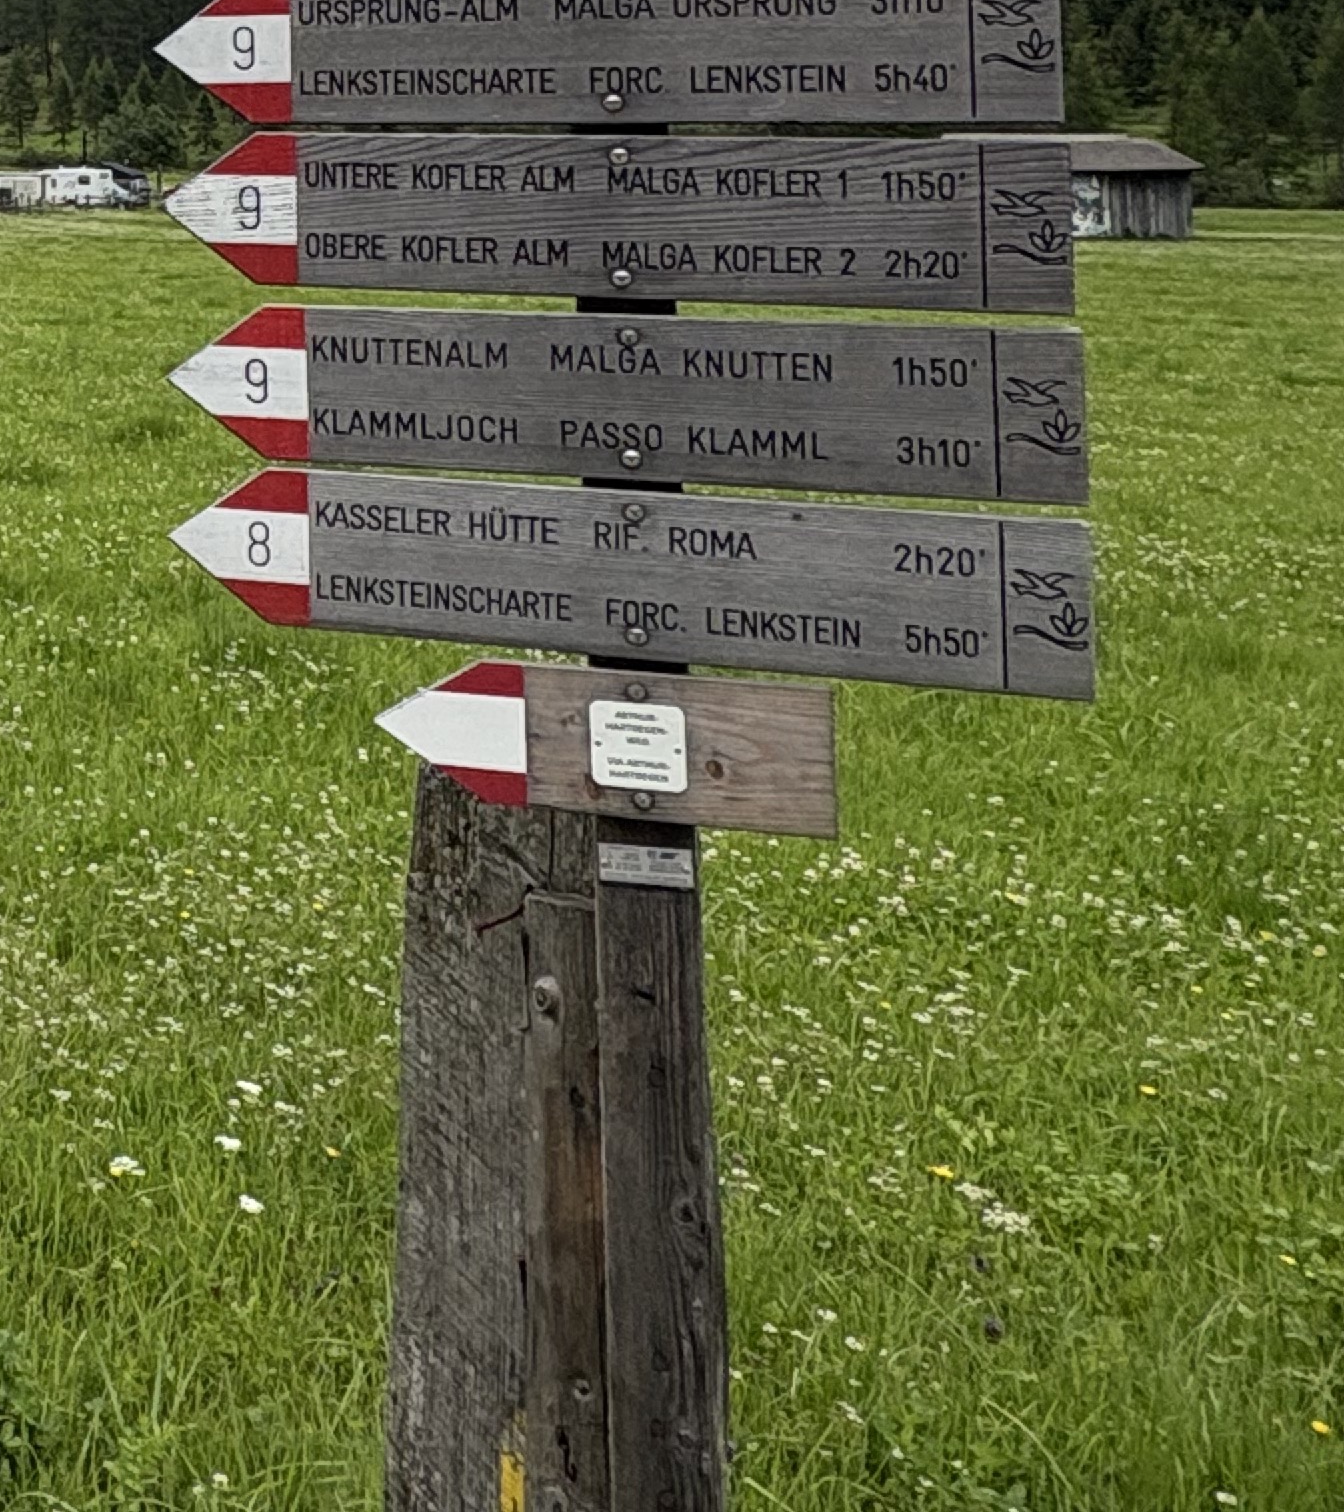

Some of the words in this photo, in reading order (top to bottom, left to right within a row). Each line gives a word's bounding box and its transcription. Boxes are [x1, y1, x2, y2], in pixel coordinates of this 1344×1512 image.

[233, 26, 255, 70] 9
[299, 66, 556, 96] LENKSTEINSCHARTE
[690, 65, 846, 94] LENKSTEIN
[305, 161, 398, 189] UNTERE
[412, 163, 506, 192] KOFLER
[521, 164, 575, 192] ALM
[607, 166, 700, 196] MALGA
[716, 168, 821, 199] KOFLER
[838, 169, 849, 200] 1
[238, 185, 261, 230] 9
[305, 233, 385, 260] OBERE
[402, 235, 499, 265] KOFLER
[512, 238, 569, 266] ALM
[602, 241, 698, 272] MALGA
[714, 244, 823, 275] KOFLER
[840, 248, 857, 276] 2
[244, 358, 268, 404] 9
[312, 335, 508, 369] KNUTTENALM
[549, 344, 662, 376] MALGA
[683, 349, 833, 383] KNUTTEN
[313, 408, 518, 444] KLAMMLJOCH
[560, 420, 663, 451] PASSO
[687, 425, 830, 461] KLAMML
[248, 521, 271, 567] 8
[315, 500, 451, 537] KASSELER
[468, 506, 559, 545] HÜTTE
[593, 521, 649, 553] RIF.
[668, 526, 758, 561] ROMA
[316, 572, 572, 622] LENKSTEINSCHARTE
[606, 598, 687, 633] FORC.
[706, 606, 862, 648] LENKSTEIN
